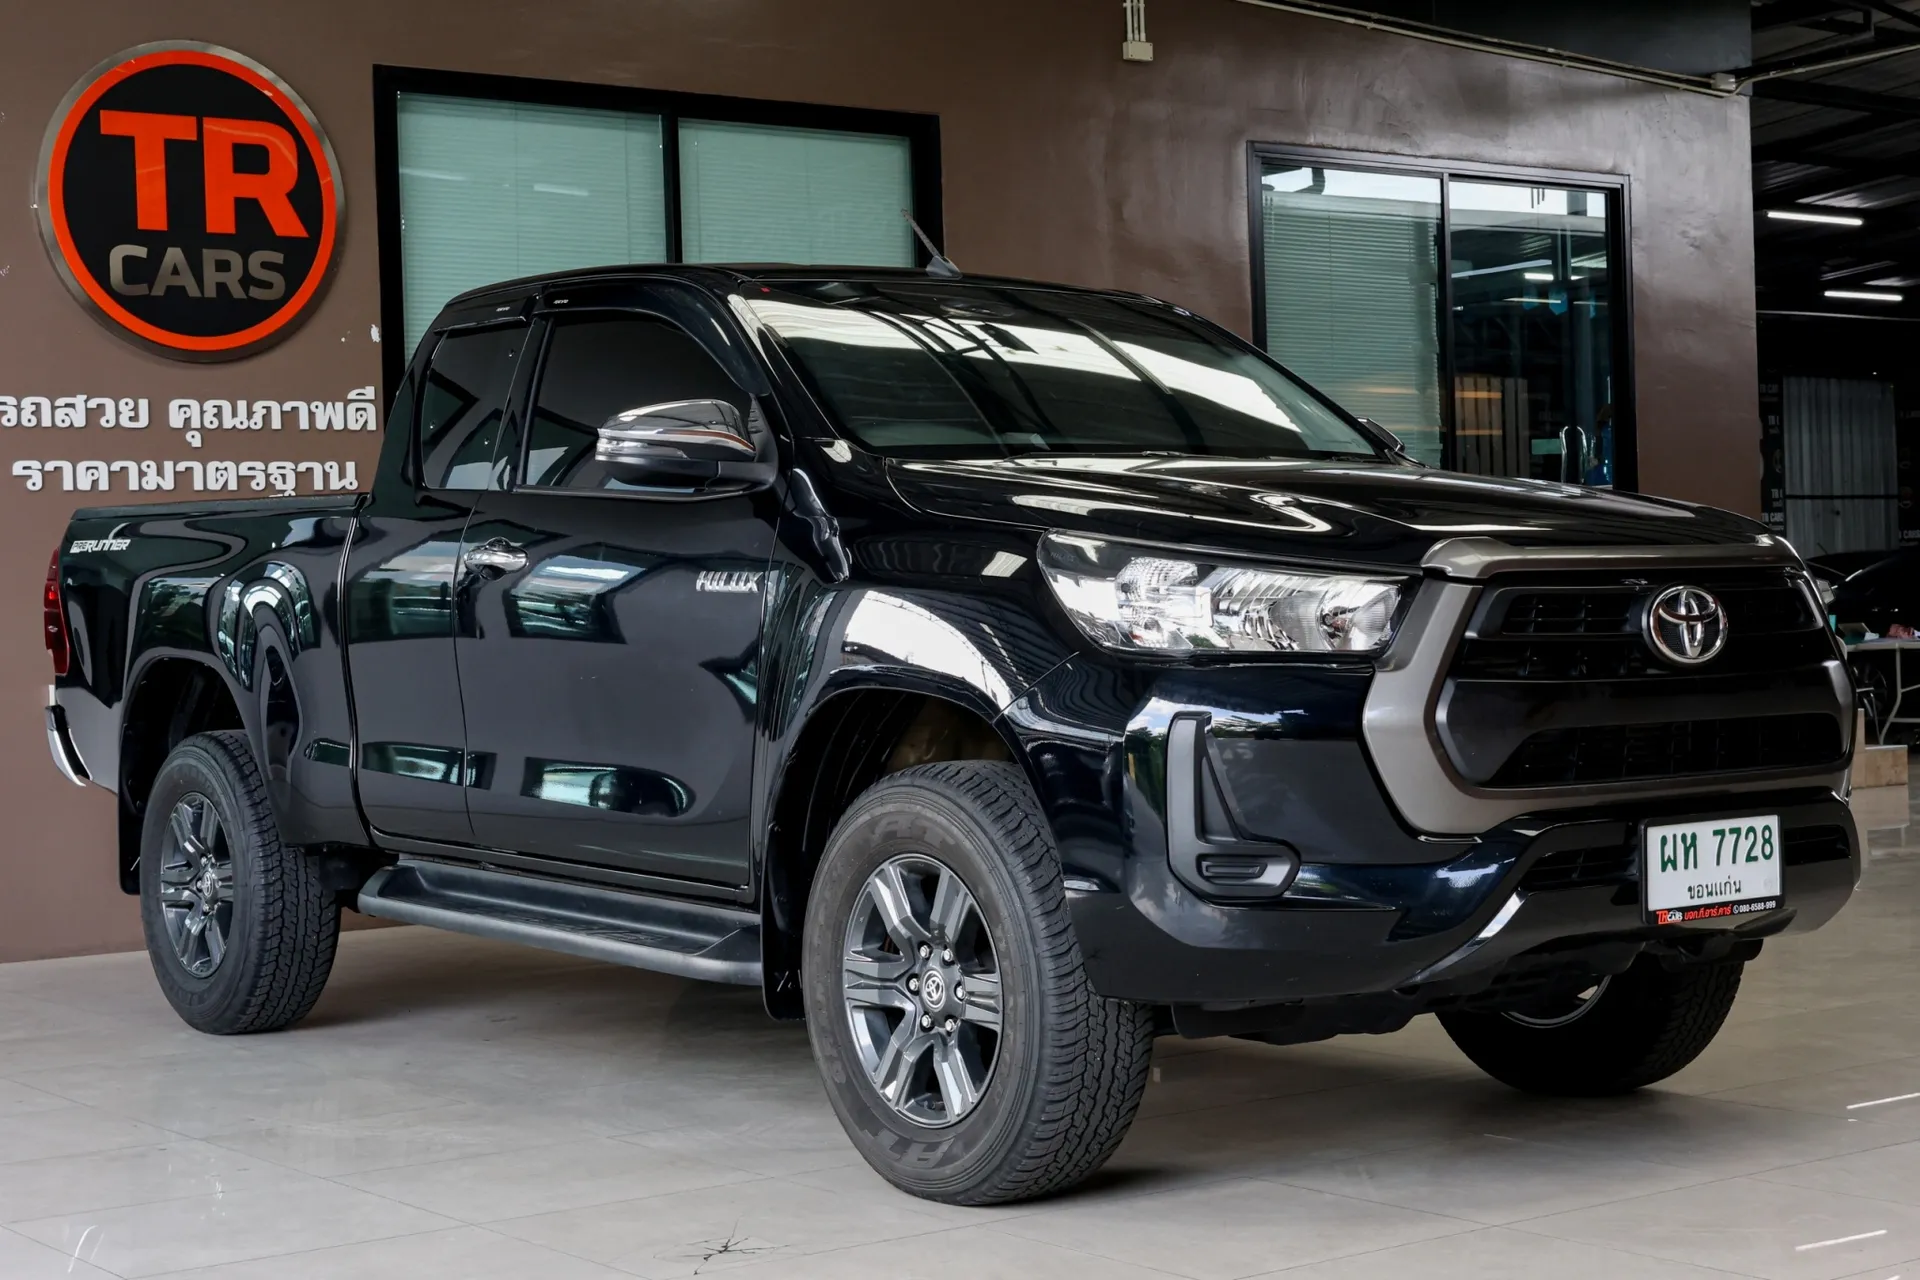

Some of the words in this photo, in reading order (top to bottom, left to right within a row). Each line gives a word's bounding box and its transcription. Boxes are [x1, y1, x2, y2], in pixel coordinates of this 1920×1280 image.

[100, 109, 310, 238] TR
[109, 244, 287, 301] CARS
[0, 394, 150, 430] รถสวย
[168, 386, 378, 448] คุณภาพดี
[12, 459, 359, 498] ราคามาตรฐาน
[695, 570, 764, 594] HILUX
[1712, 824, 1774, 866] 7728
[1687, 875, 1742, 900] ขอนแก่น
